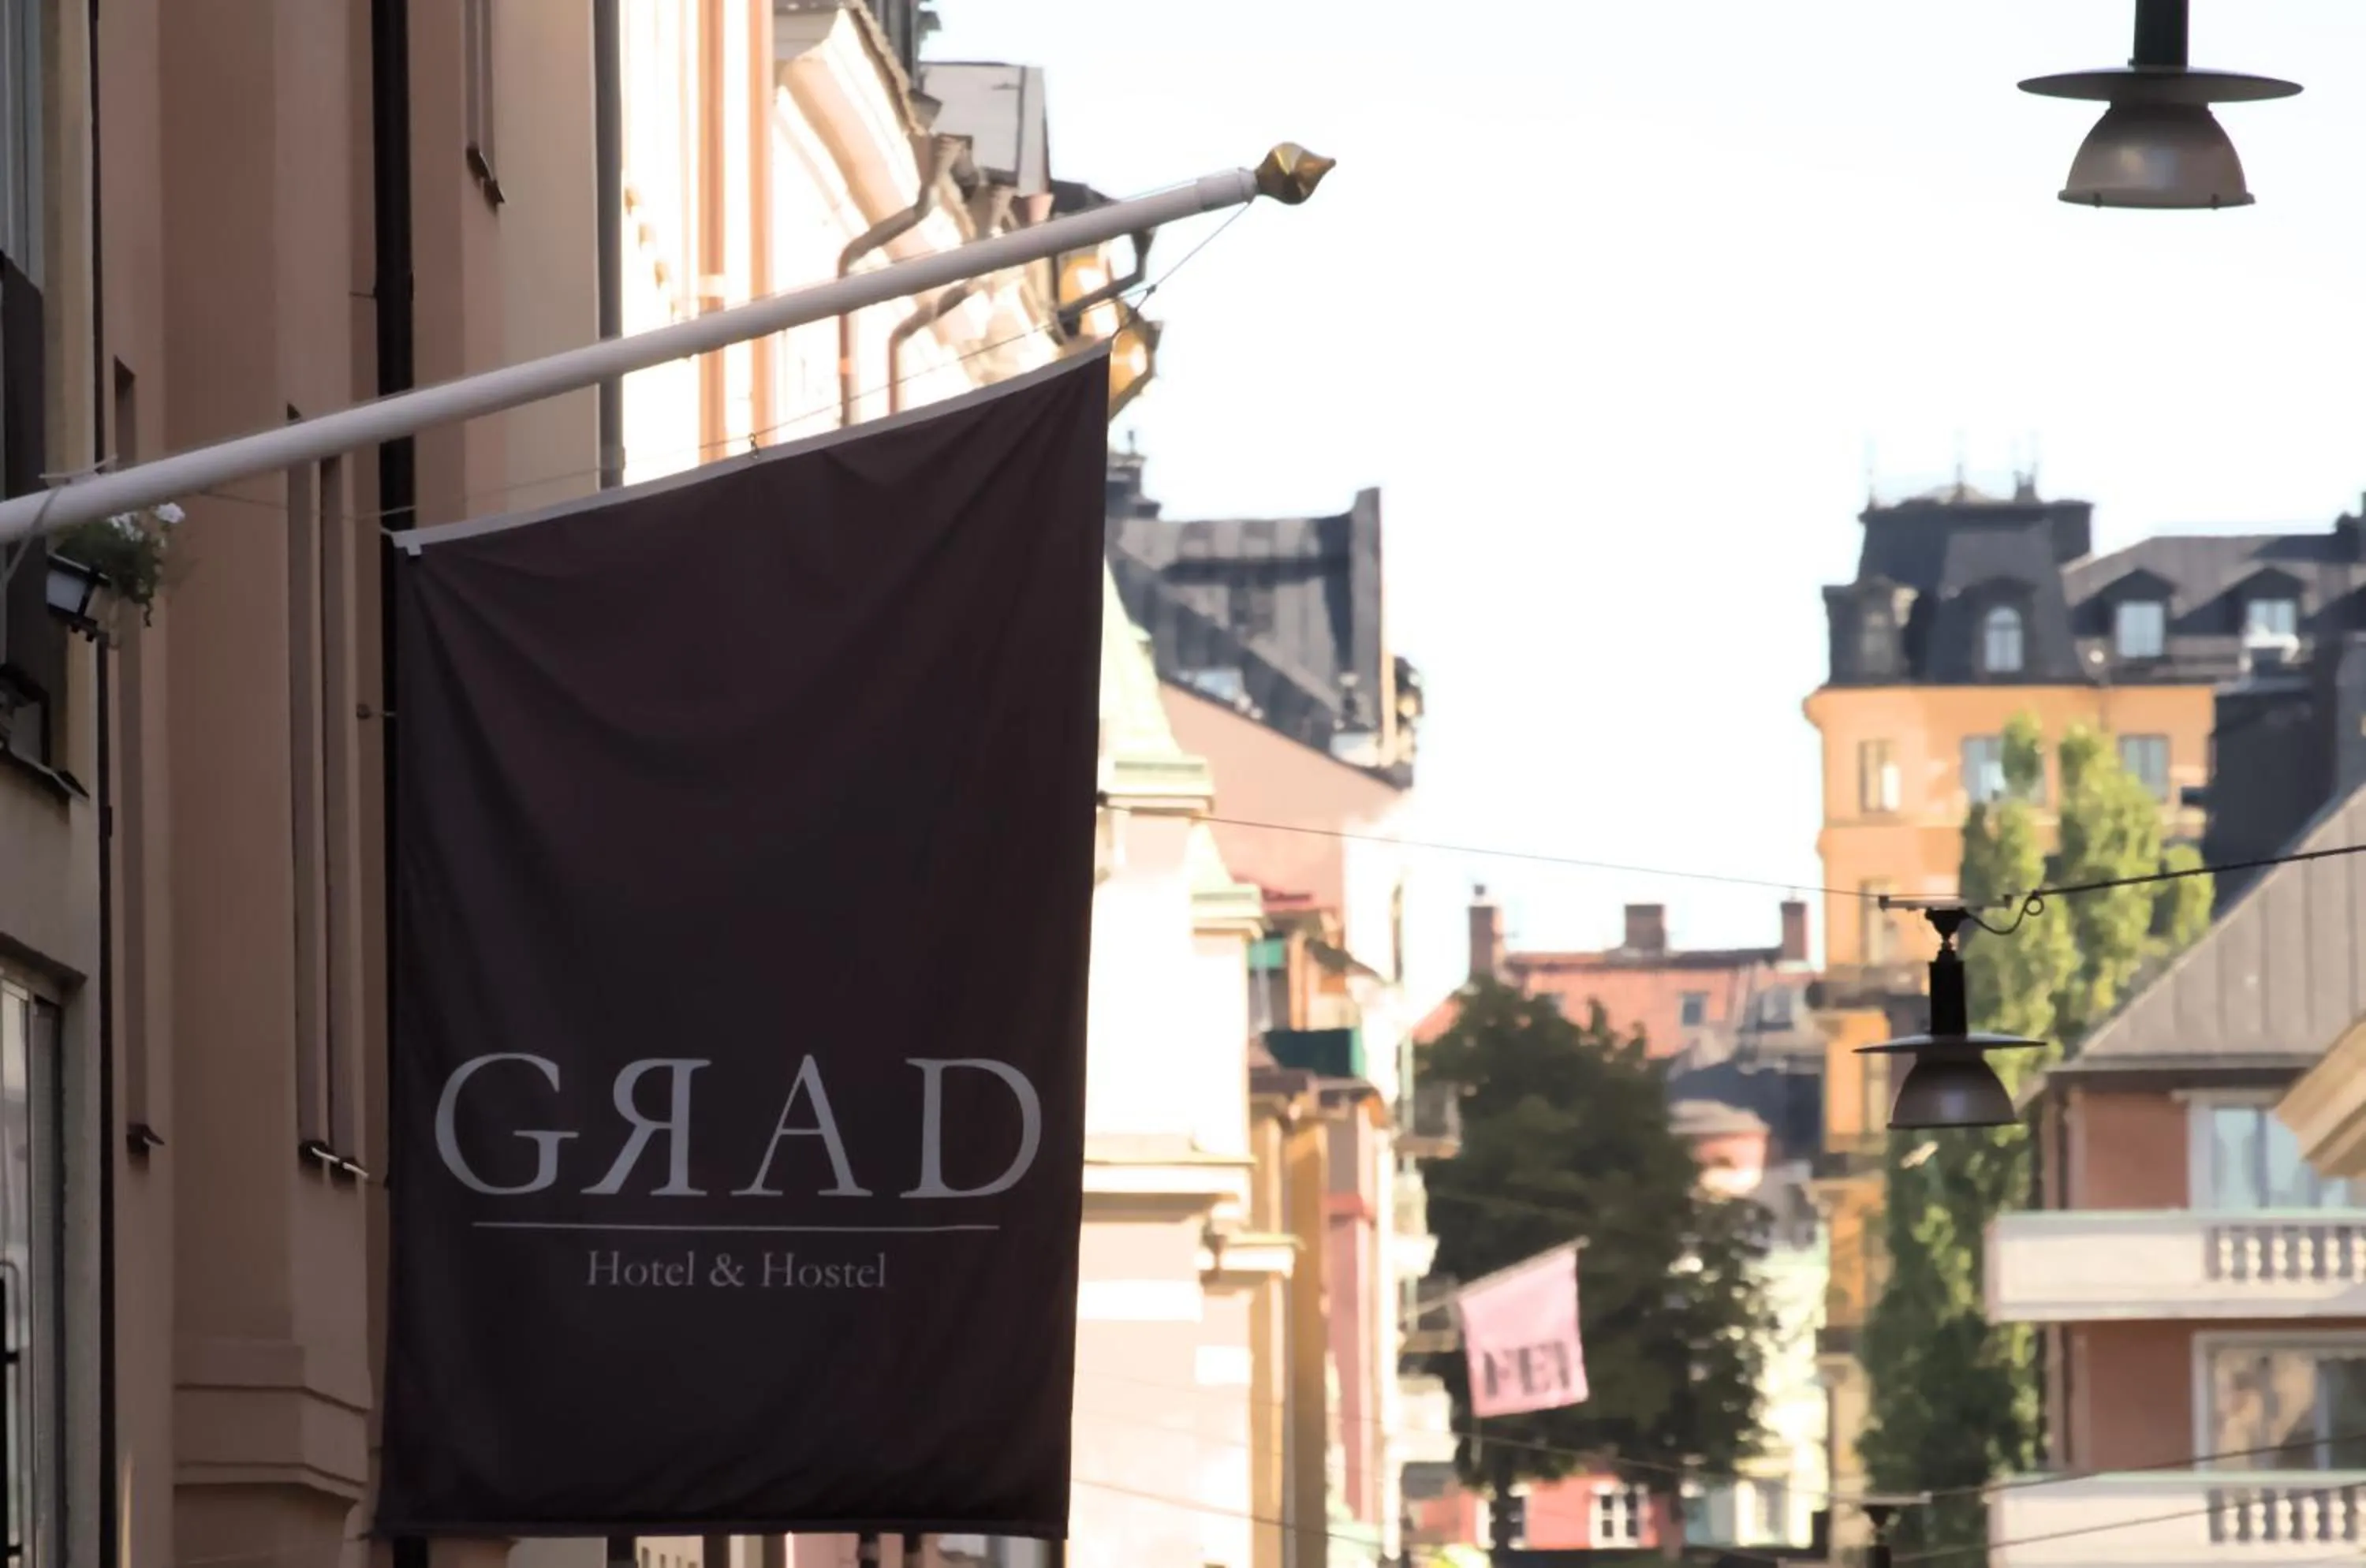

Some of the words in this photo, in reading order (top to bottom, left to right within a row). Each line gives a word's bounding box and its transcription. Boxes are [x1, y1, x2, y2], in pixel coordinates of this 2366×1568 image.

[586, 1249, 696, 1288] Hotel
[708, 1253, 745, 1288] &
[759, 1251, 888, 1289] Hostel
